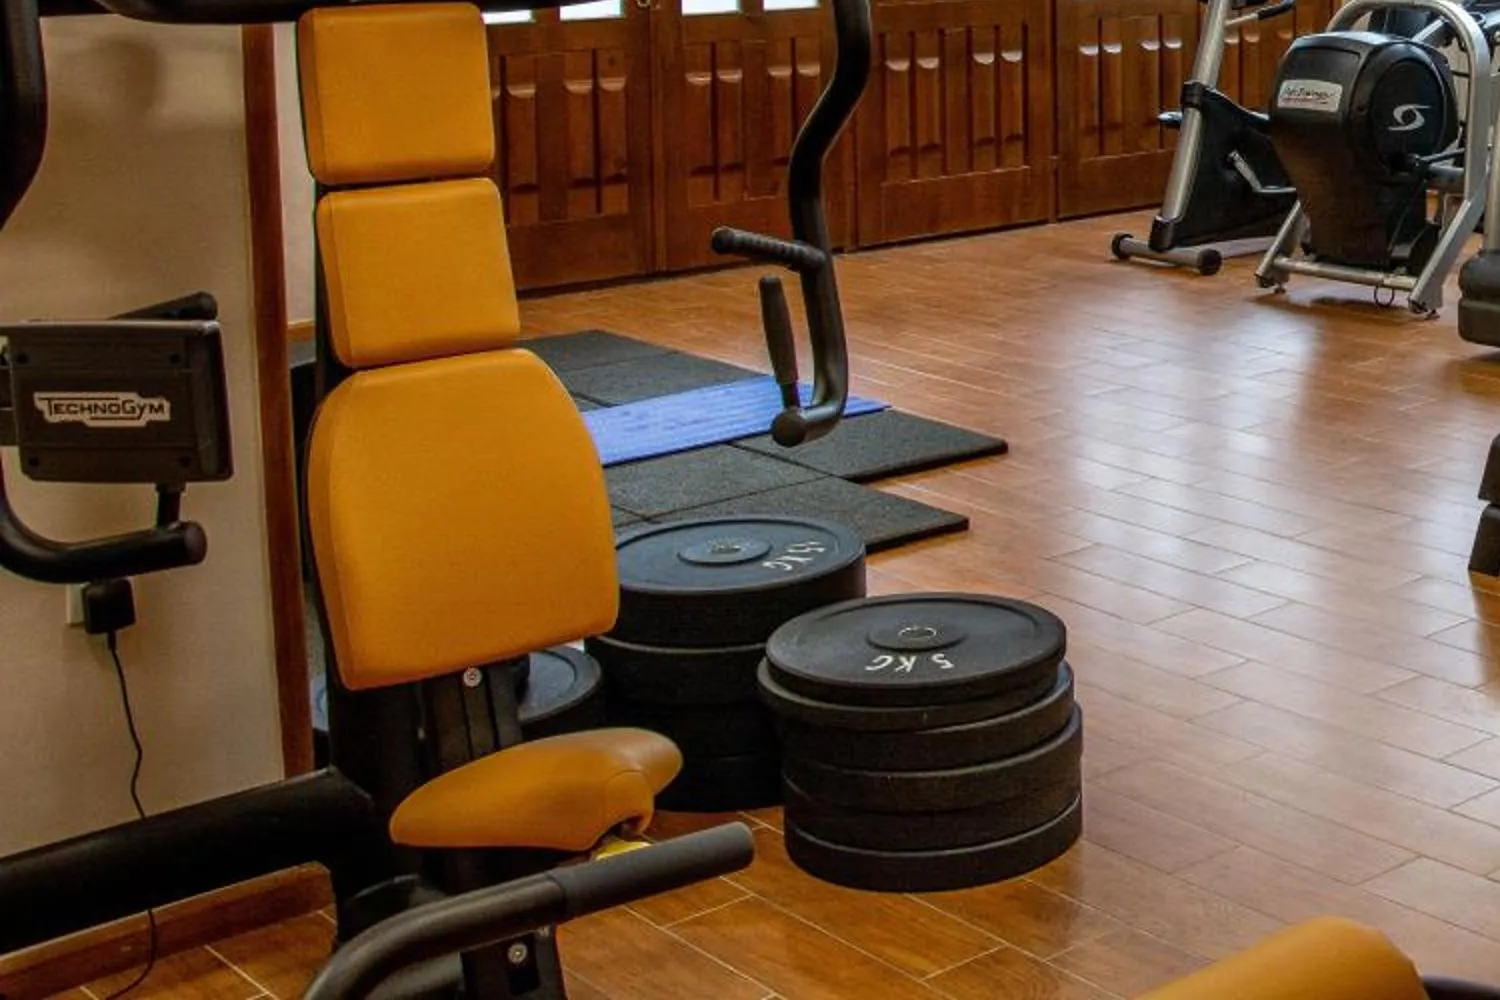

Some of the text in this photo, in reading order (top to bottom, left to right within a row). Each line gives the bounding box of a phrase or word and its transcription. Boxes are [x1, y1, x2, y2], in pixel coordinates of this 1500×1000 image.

[39, 397, 165, 420] TECHNOGYM
[864, 653, 955, 672] 5 KG
